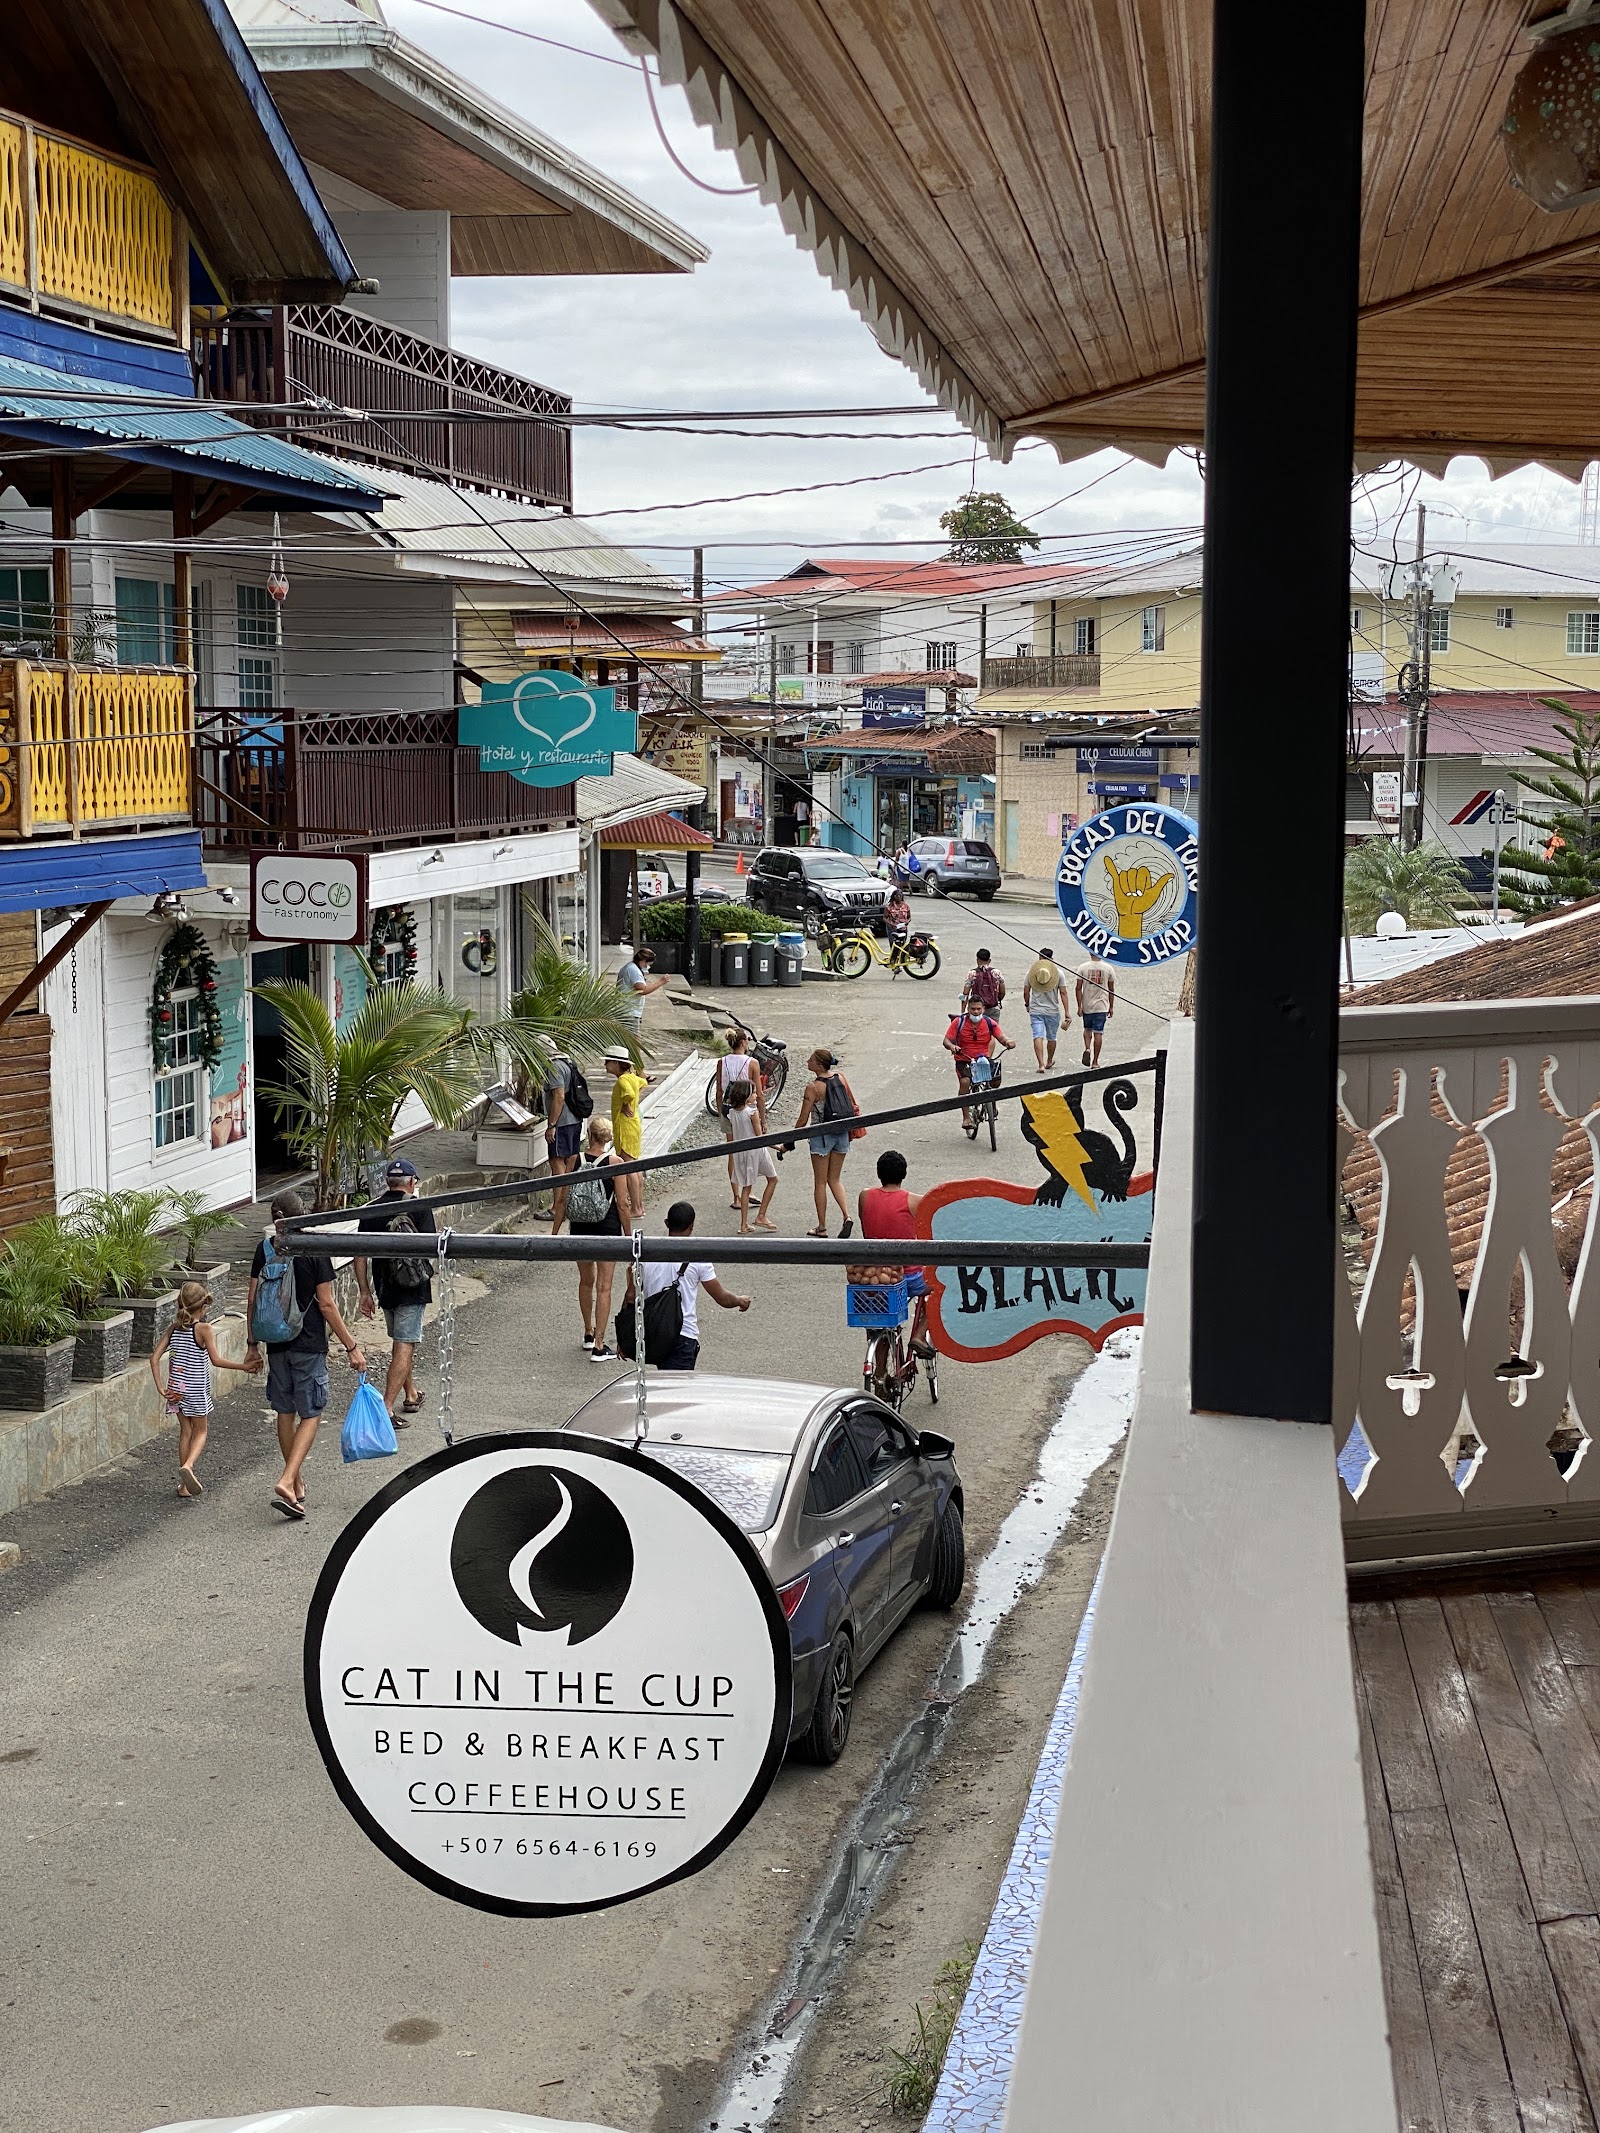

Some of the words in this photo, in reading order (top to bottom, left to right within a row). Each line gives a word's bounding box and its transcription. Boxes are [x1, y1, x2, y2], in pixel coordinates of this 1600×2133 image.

[480, 744, 516, 763] Hotel
[520, 750, 534, 775] y
[539, 748, 610, 765] restaurante
[1109, 747, 1135, 757] CELULAR
[1135, 747, 1152, 757] CHEN
[1058, 815, 1115, 886] BOCAS
[1126, 810, 1166, 839] DEL
[261, 879, 352, 908] COCO
[274, 908, 339, 922] Fastronomy
[1066, 909, 1123, 958] SURF
[1138, 919, 1192, 964] SHOP
[341, 1665, 430, 1701] CAT
[455, 1669, 501, 1703] IN
[525, 1669, 615, 1706] THE
[641, 1672, 734, 1708] CUP
[375, 1730, 444, 1756] BED
[464, 1732, 486, 1757] &
[507, 1733, 726, 1762] BREAKFAST
[407, 1781, 687, 1812] COFFEEHOUSE
[441, 1837, 504, 1856] +507
[515, 1838, 658, 1859] 6564-6169
